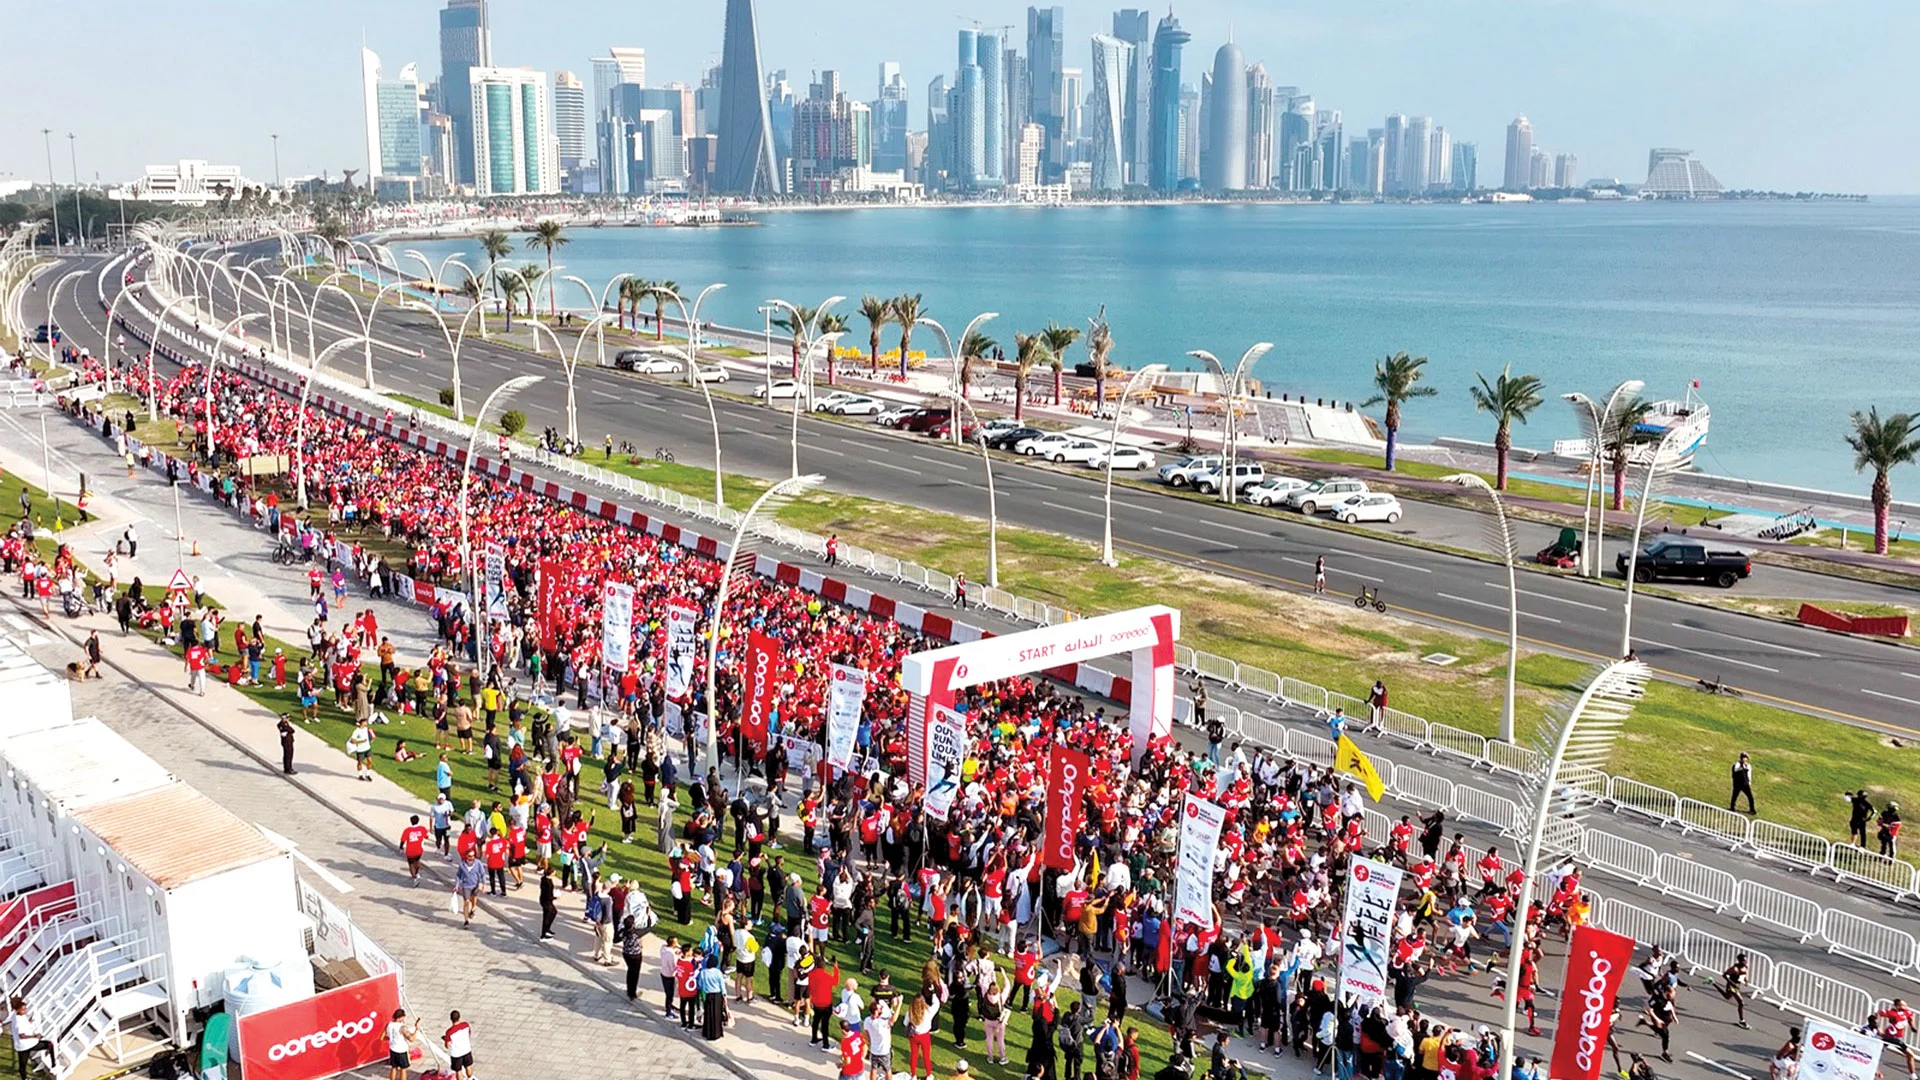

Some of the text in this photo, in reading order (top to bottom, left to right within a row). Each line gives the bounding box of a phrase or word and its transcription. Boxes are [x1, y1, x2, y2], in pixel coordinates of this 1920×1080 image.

[1110, 625, 1151, 642] ooredoo
[1019, 644, 1056, 662] START
[749, 647, 769, 726] ooredoo
[933, 741, 957, 758] YOUR
[934, 733, 953, 746] RUN
[1058, 757, 1078, 859] ooredoo
[1575, 950, 1612, 1072] ooredoo
[268, 1011, 377, 1061] ooredoo
